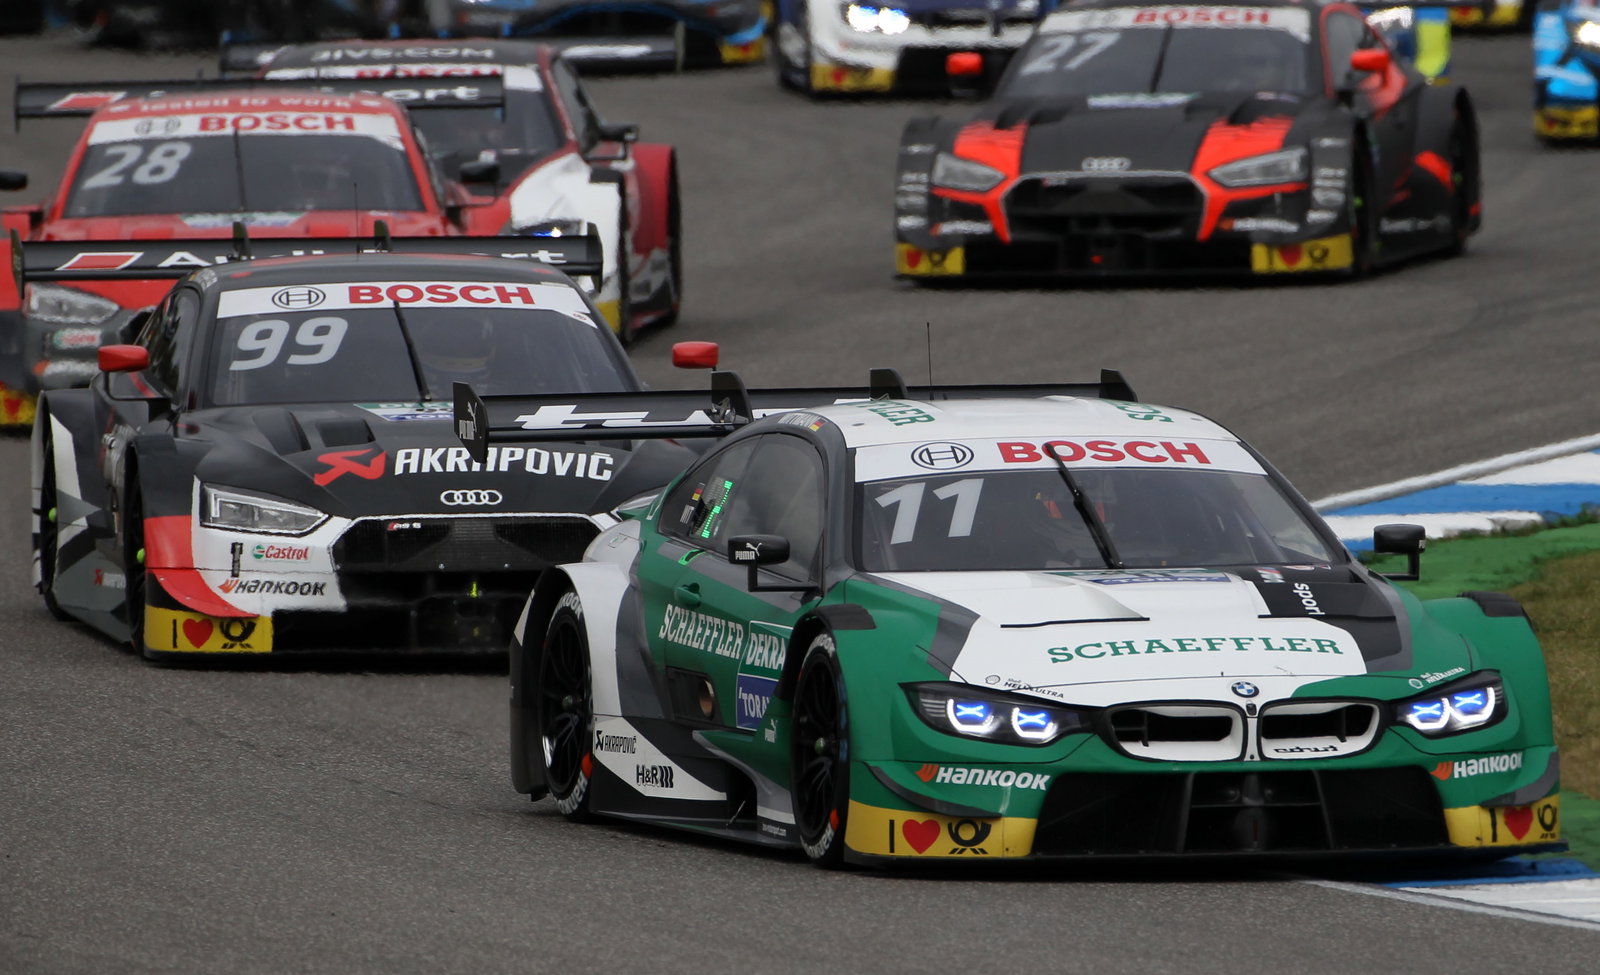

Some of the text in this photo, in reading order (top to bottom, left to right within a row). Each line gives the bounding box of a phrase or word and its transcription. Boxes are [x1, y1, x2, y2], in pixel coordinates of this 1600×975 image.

[1132, 11, 1270, 24] BOSCH
[1021, 32, 1122, 76] 27
[198, 114, 355, 132] BOSCH
[81, 141, 192, 190] 28
[348, 284, 536, 305] BOSCH
[228, 316, 349, 371] 99
[996, 440, 1211, 464] BOSCH
[874, 478, 985, 545] 11
[265, 545, 311, 560] Castrol
[735, 550, 755, 561] PUMA
[658, 603, 745, 660] SCHAEFFLER
[745, 632, 788, 671] DEKRA
[1047, 637, 1344, 664] SCHAEFFLER
[636, 764, 659, 786] H&R
[888, 819, 895, 854] I
